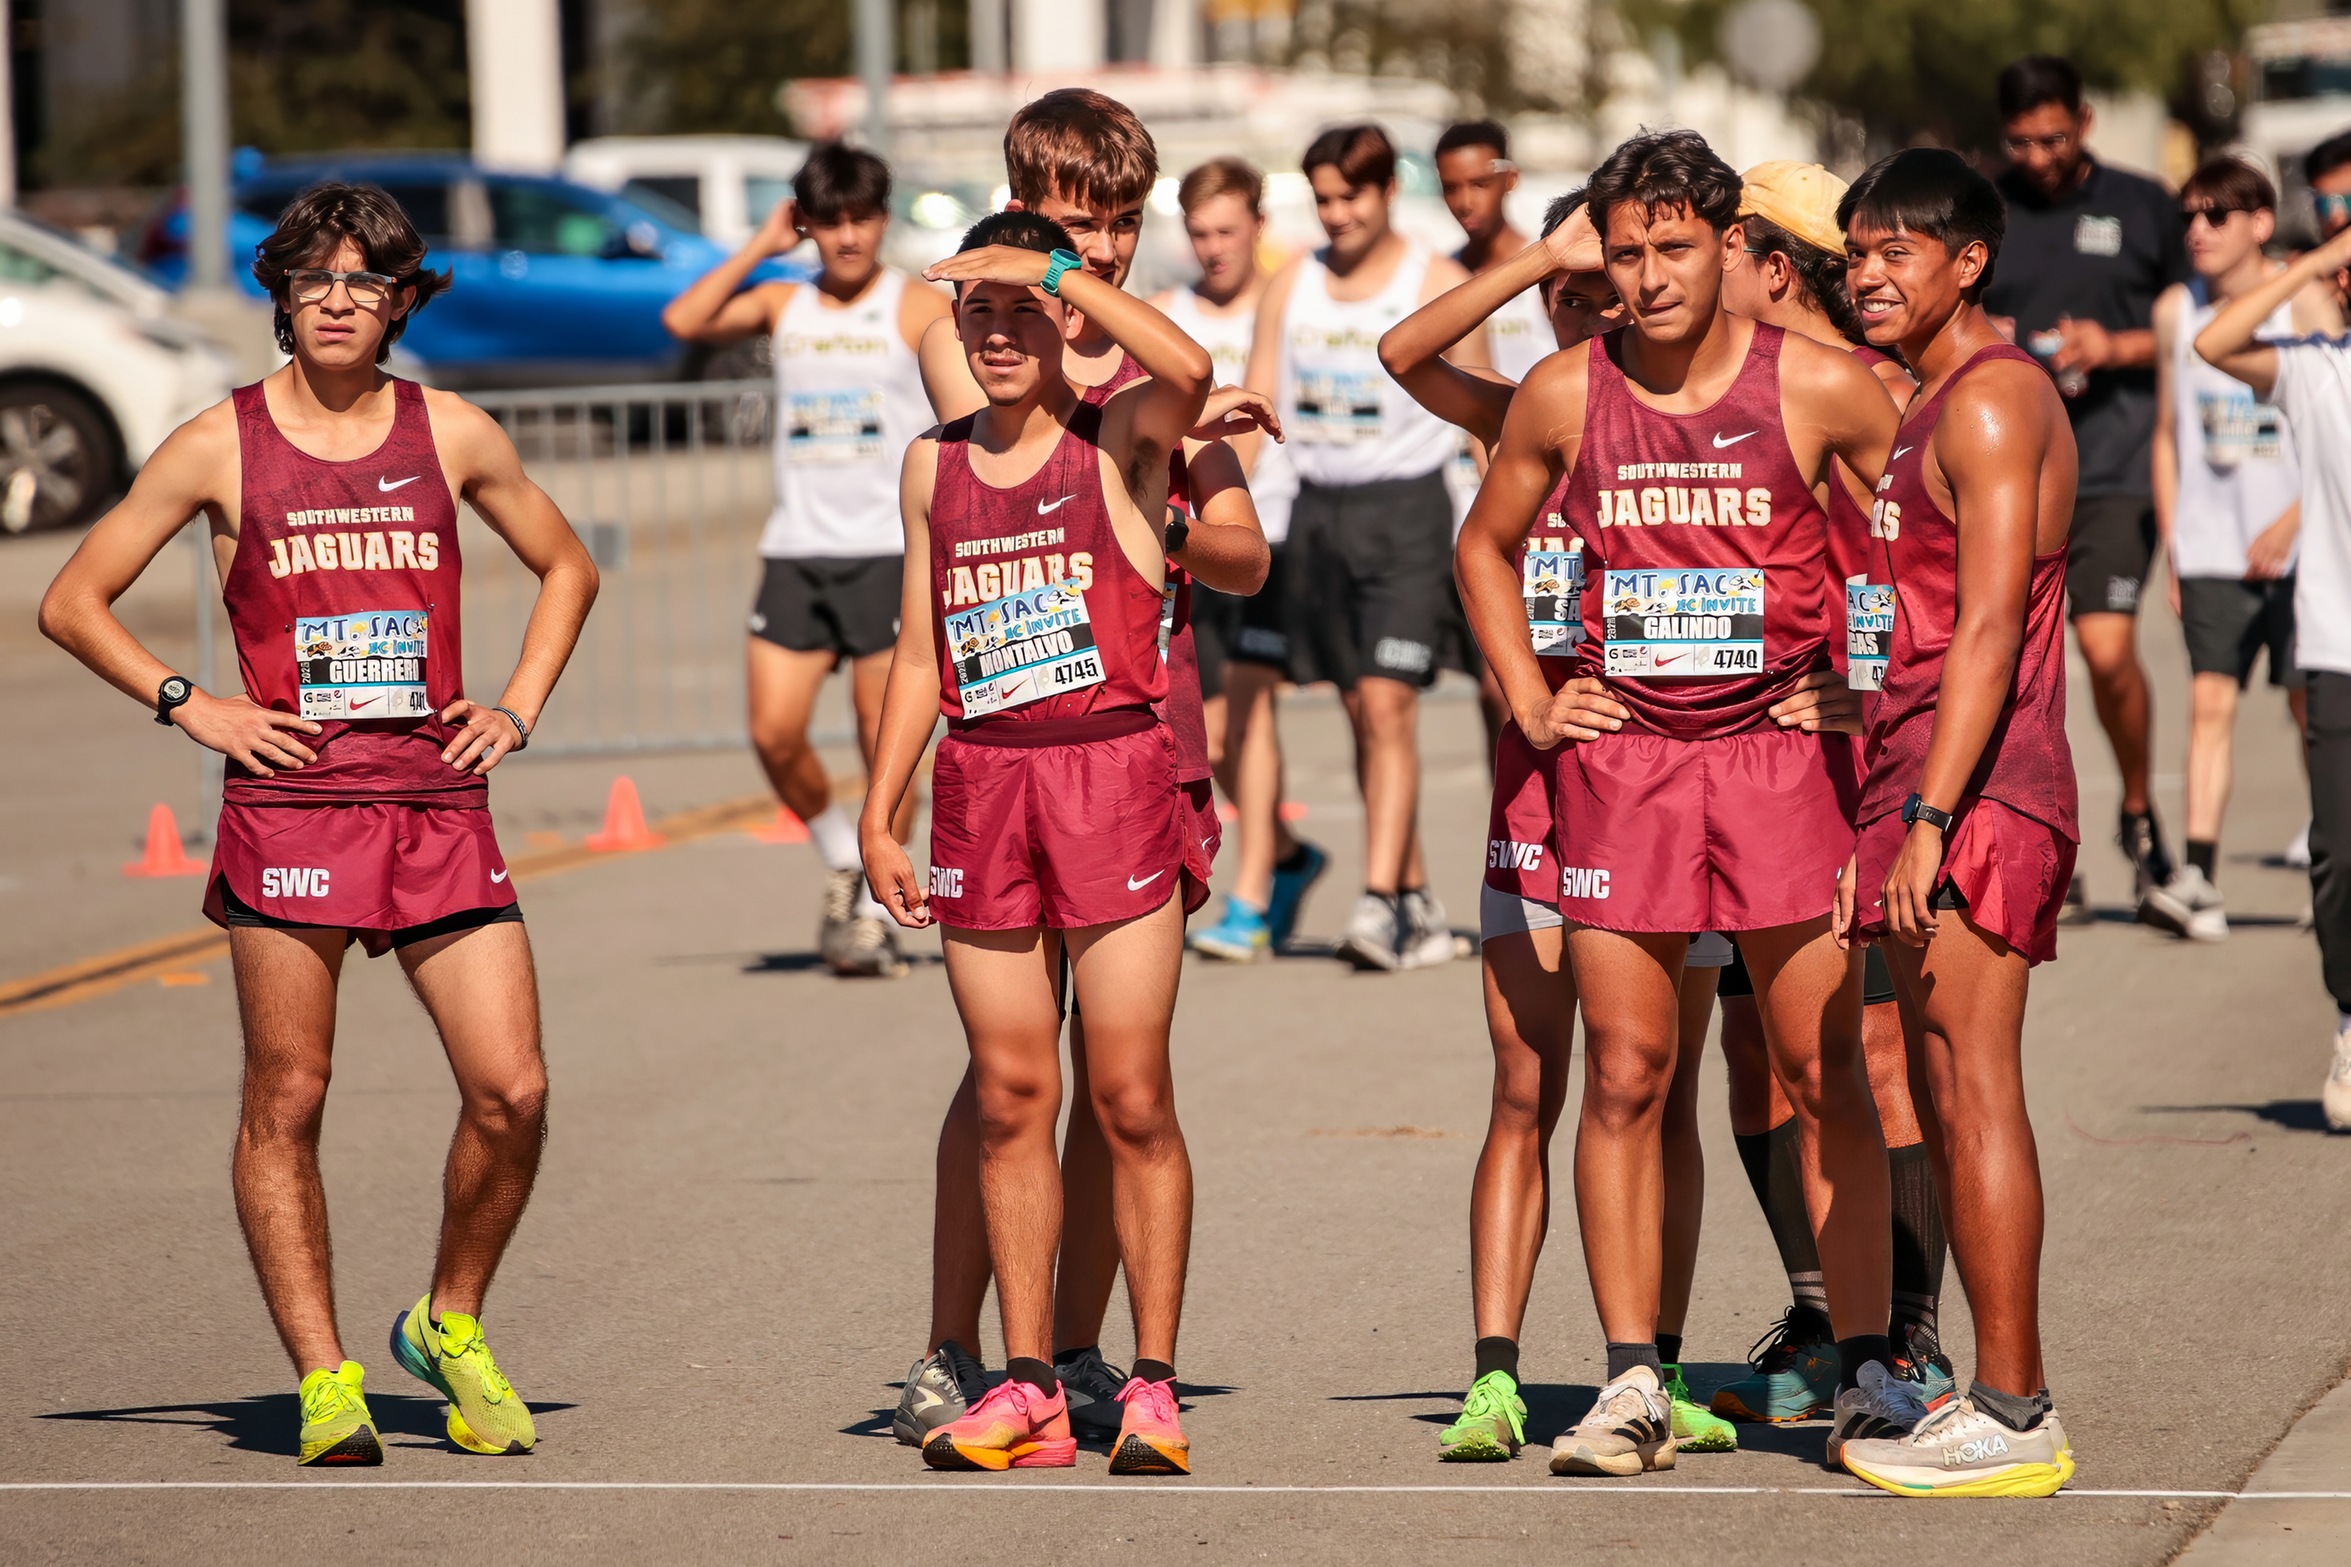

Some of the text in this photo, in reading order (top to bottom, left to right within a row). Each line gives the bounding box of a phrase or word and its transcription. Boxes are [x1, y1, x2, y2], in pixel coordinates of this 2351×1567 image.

[1617, 462, 1742, 481] SOUTHWESTERN
[286, 506, 414, 527] SOUTHWESTERN
[1597, 486, 1772, 528] JAGUARS
[267, 531, 439, 580] JAGUARS
[955, 527, 1065, 557] SOUTHWESTERN
[943, 551, 1093, 609] JAGUARS
[1613, 573, 1728, 597] MT. SAC
[953, 593, 1049, 641] MT. SAC
[1701, 597, 1757, 612] INVITE
[303, 616, 412, 641] MT. SAC
[1027, 607, 1082, 635] INVITE
[1643, 616, 1732, 640] GALINDO
[392, 639, 424, 656] INVITE
[978, 630, 1075, 678] MONTALVO
[329, 658, 420, 684] GUERRERO
[1054, 657, 1099, 685] 4745
[1489, 839, 1543, 871] SWC
[262, 867, 330, 898] SWC
[930, 865, 964, 898] SWC
[1563, 866, 1611, 899] SWC
[1941, 1433, 2009, 1467] HOKA
